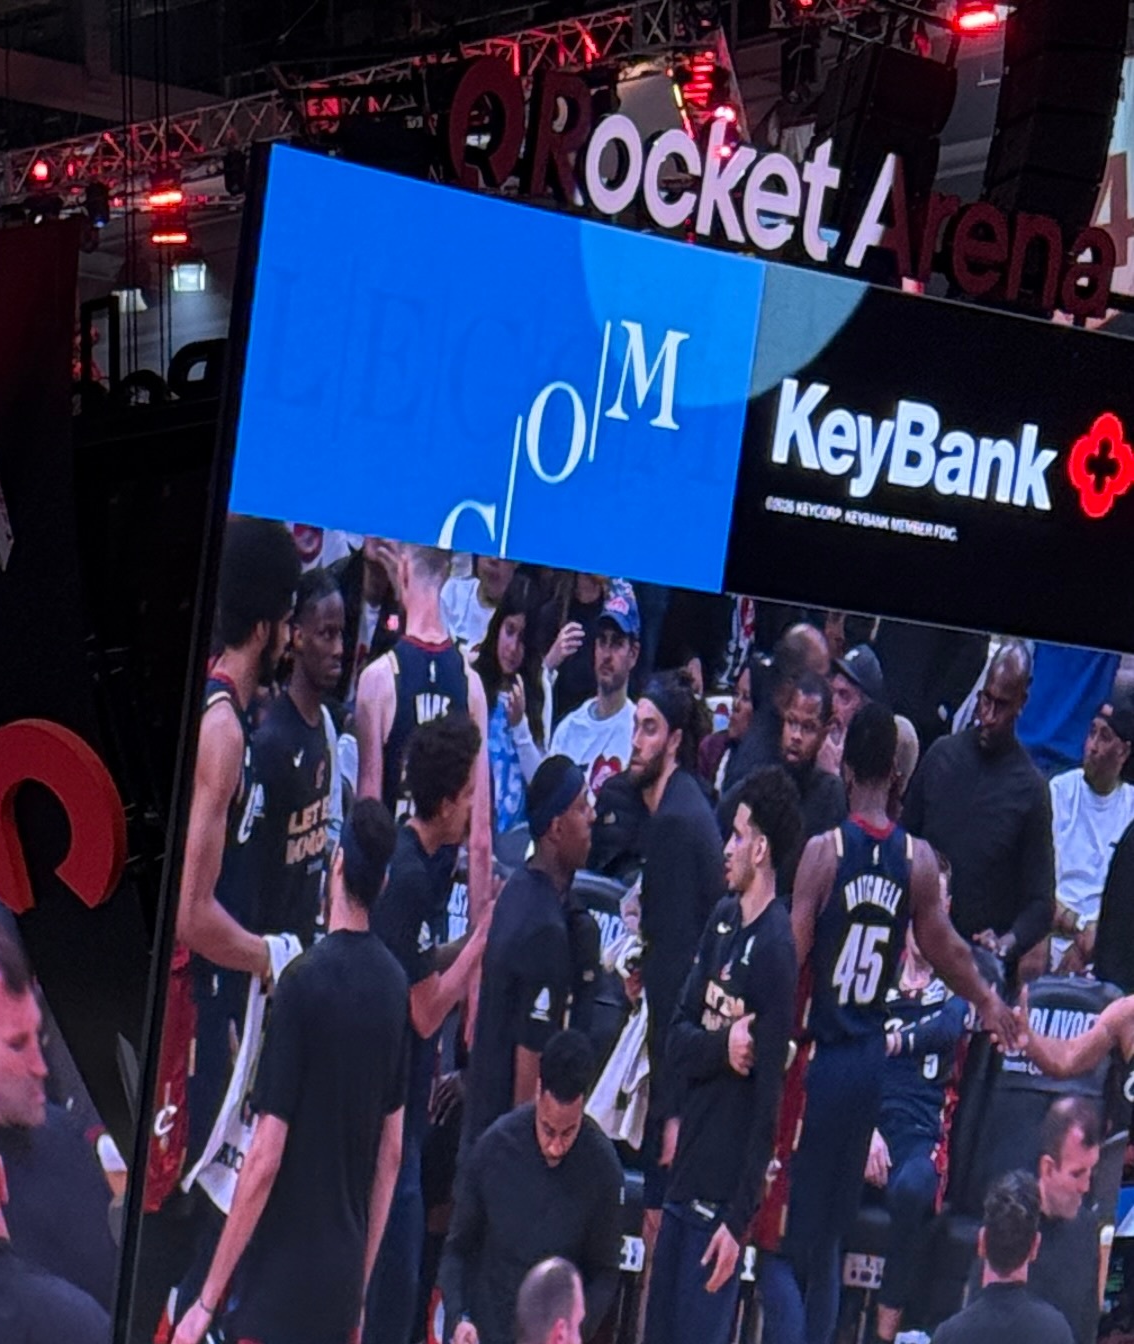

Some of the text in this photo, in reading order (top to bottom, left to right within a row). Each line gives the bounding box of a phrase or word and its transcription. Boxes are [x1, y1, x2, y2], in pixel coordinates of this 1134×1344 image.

[528, 68, 1118, 316] Rocket Arena
[772, 377, 1058, 511] KeyBank
[844, 874, 905, 917] MITCHELL
[831, 923, 890, 1006] 45
